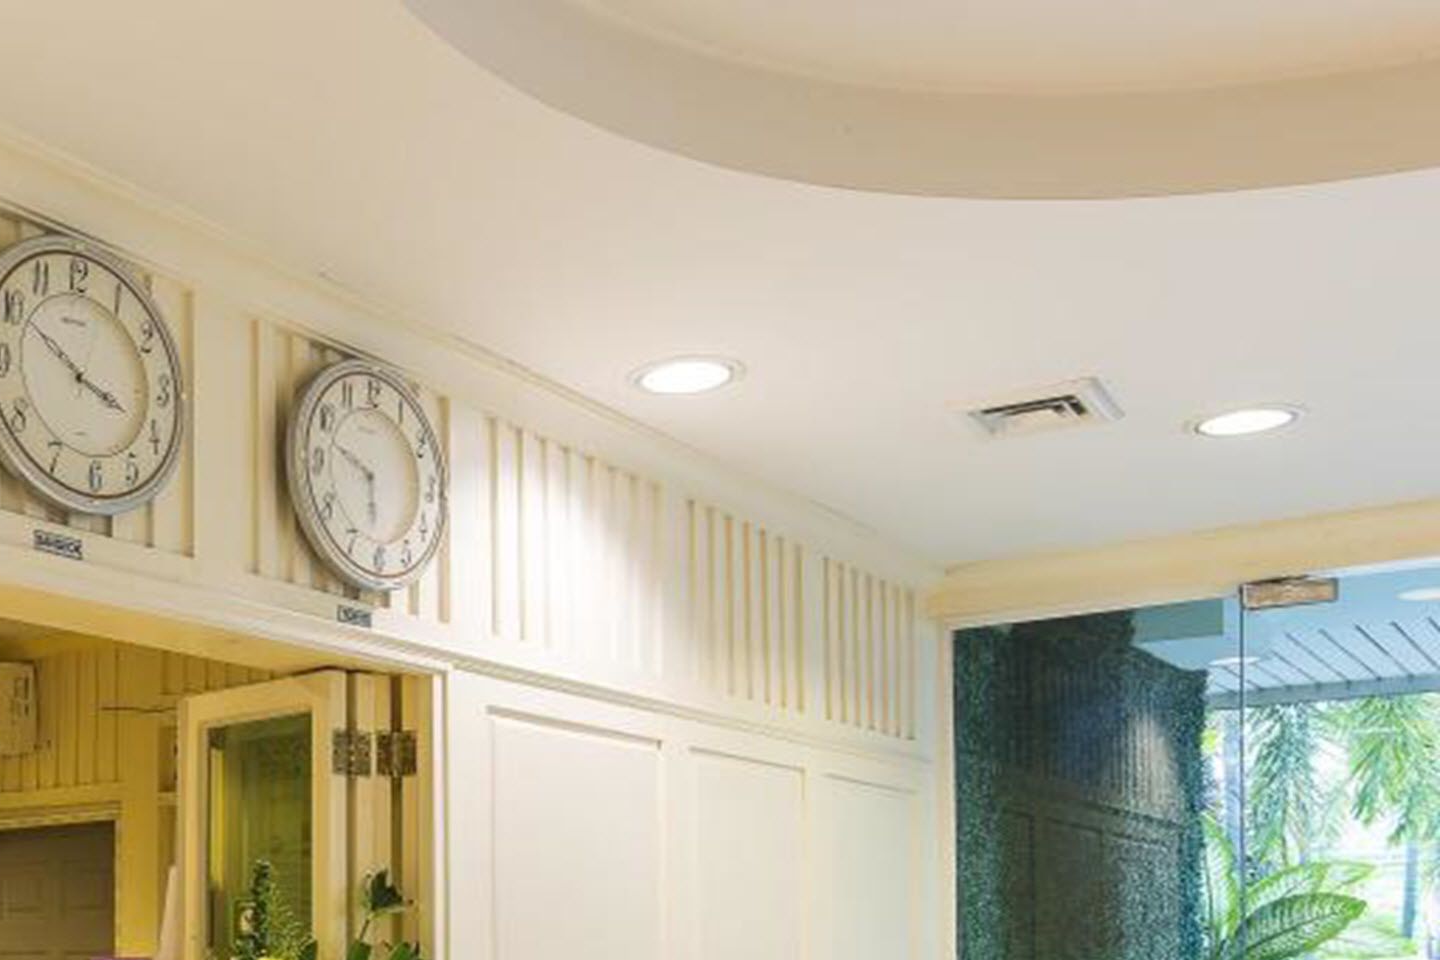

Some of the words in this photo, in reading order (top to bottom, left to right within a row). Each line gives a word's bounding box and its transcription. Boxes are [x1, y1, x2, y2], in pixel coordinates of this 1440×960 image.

[33, 259, 49, 297] 11
[69, 257, 89, 294] 12
[4, 289, 24, 326] 10
[114, 282, 122, 317] 1
[139, 321, 153, 353] 2
[156, 373, 170, 408] 3
[11, 398, 28, 433] 8
[149, 419, 161, 455] 4
[48, 440, 64, 474] 7
[124, 452, 139, 486] 5
[89, 459, 102, 491] 6
